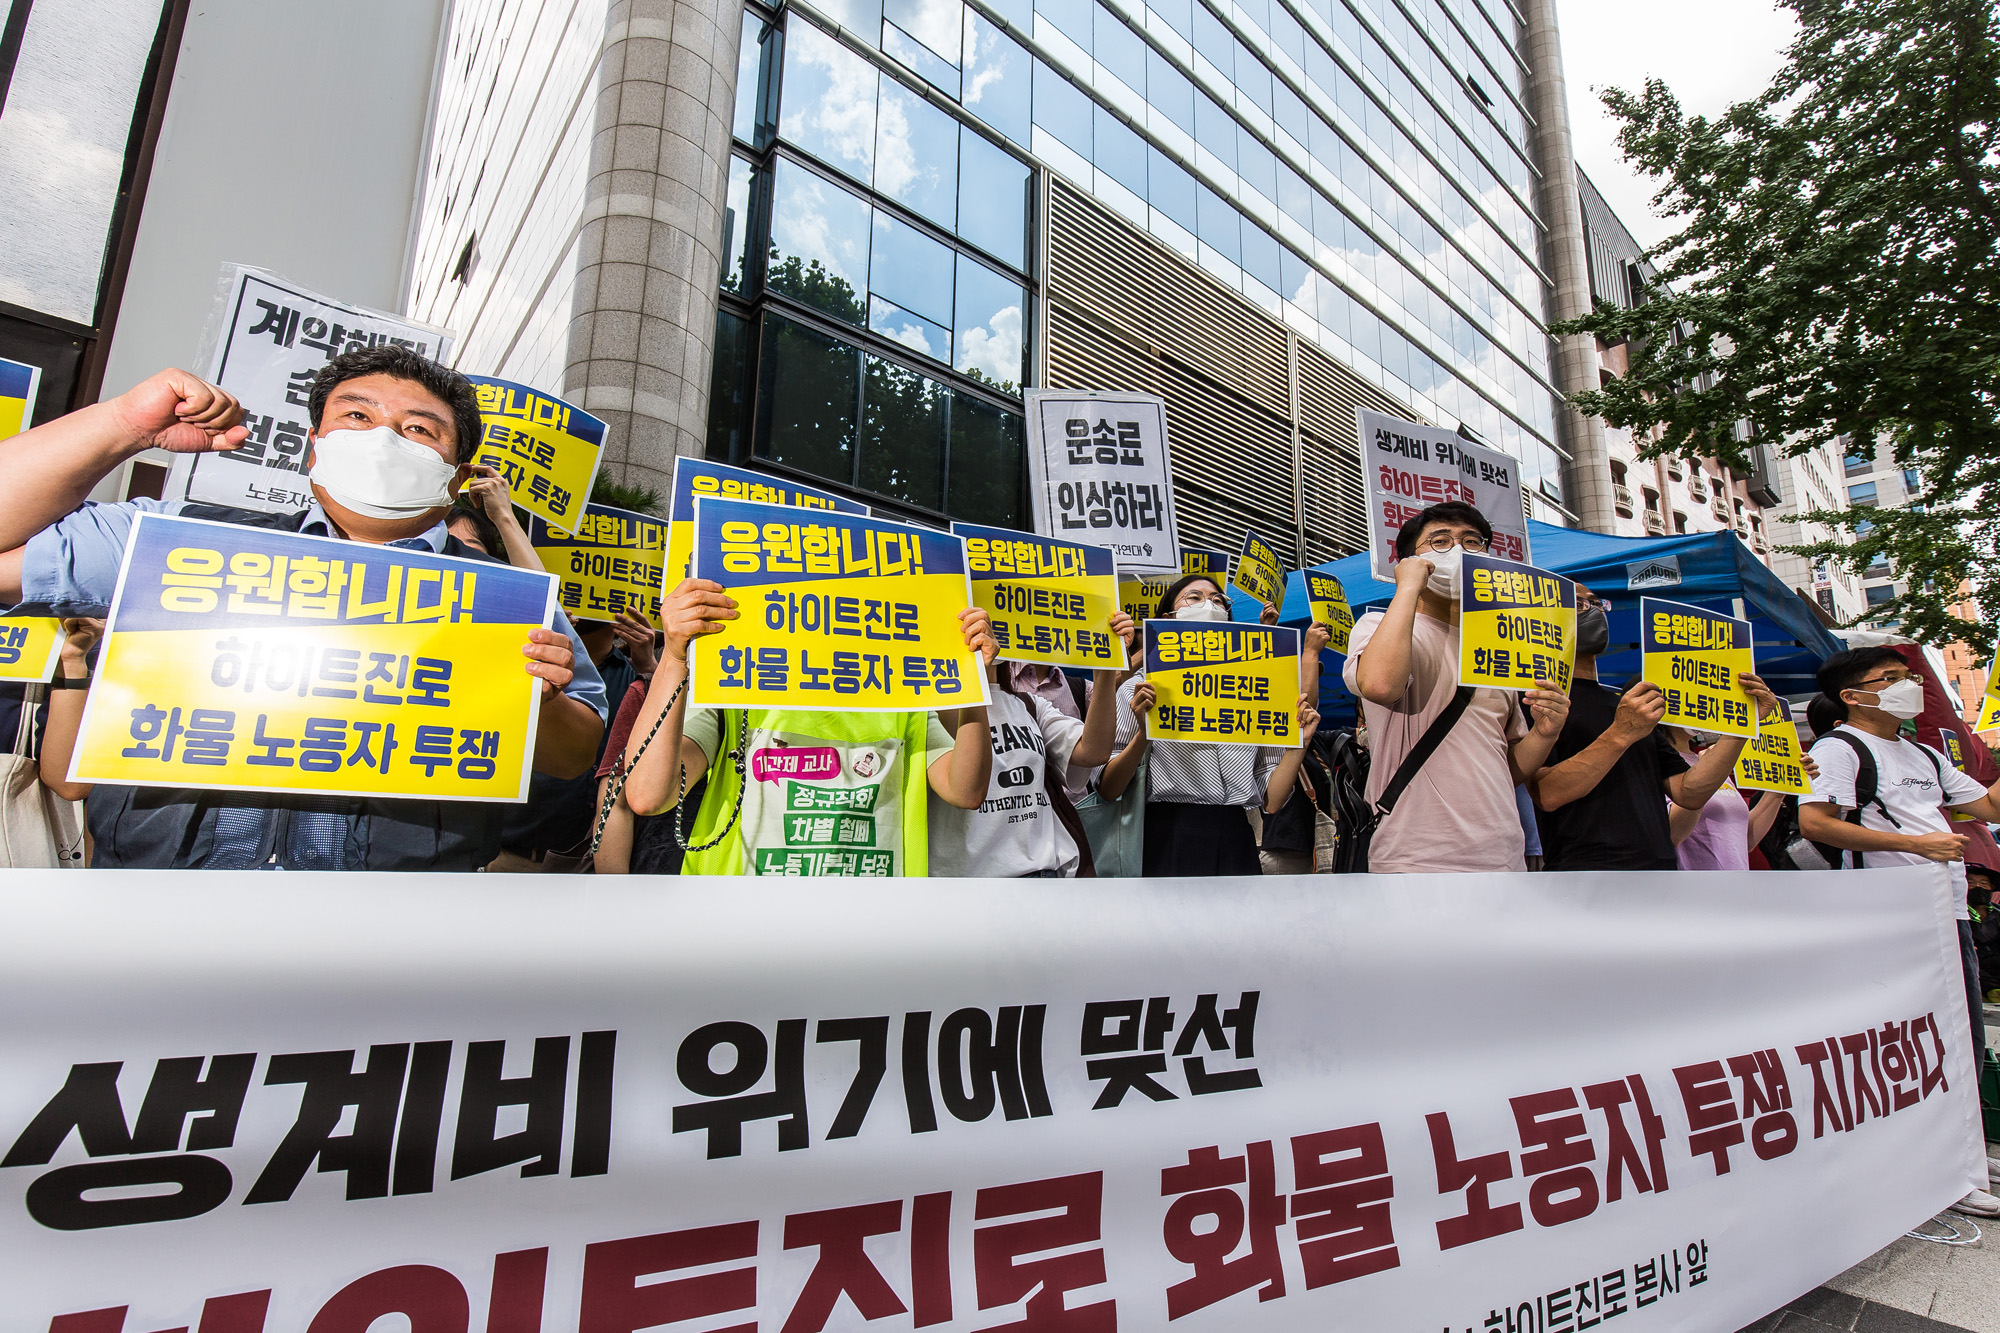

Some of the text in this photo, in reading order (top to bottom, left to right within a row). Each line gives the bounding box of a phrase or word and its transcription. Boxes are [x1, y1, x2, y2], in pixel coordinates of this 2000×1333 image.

[470, 383, 571, 434] 합니다!
[1065, 418, 1145, 467] 운송료
[1375, 427, 1510, 489] 생계비 위기에 맞선
[527, 474, 572, 517] 투쟁
[1057, 480, 1164, 532] 인상하라
[720, 520, 924, 577] 응원합니다!
[966, 537, 1087, 577] 응원합니다!
[1489, 530, 1524, 563] 투쟁
[160, 547, 477, 624] 응원합니다!
[1239, 572, 1259, 593] 화물
[1472, 568, 1563, 608] 응원합니다!
[1630, 565, 1678, 585] CARAVAN
[764, 589, 921, 642] 하이트진로
[993, 582, 1086, 621] 하이트진로
[1015, 622, 1071, 656] 노동자
[1075, 630, 1112, 659] 투쟁
[1157, 630, 1274, 663] 응원합니다!
[1496, 612, 1563, 652] 하이트진로
[1653, 612, 1734, 650] 응원합니다!
[210, 635, 453, 708] 하이트진로
[718, 644, 962, 695] 화물 노동자 투쟁
[1182, 671, 1270, 701] 하이트진로
[1473, 647, 1570, 691] 화물 노동자 투쟁
[1671, 655, 1731, 691] 하이트진로
[1158, 704, 1289, 737] 화물 노동자 투쟁
[1684, 691, 1720, 723] 노동자
[1723, 699, 1749, 728] 투쟁
[122, 703, 500, 780] 화물 노동자 투쟁
[755, 754, 799, 774] 기간제
[801, 754, 833, 773] 교사
[1741, 757, 1803, 787] 화물 노동자 투쟁
[793, 784, 874, 809] 정규직화
[789, 817, 870, 843] 차별 철폐
[761, 852, 891, 877] 노동기본권 보장
[0, 990, 1264, 1231] 생계비 위기에 맞선
[46, 1011, 1949, 1333] 트진로 화물 노동자 투쟁 지지한다
[1633, 1248, 1682, 1309] 본사
[1686, 1238, 1709, 1288] 앞
